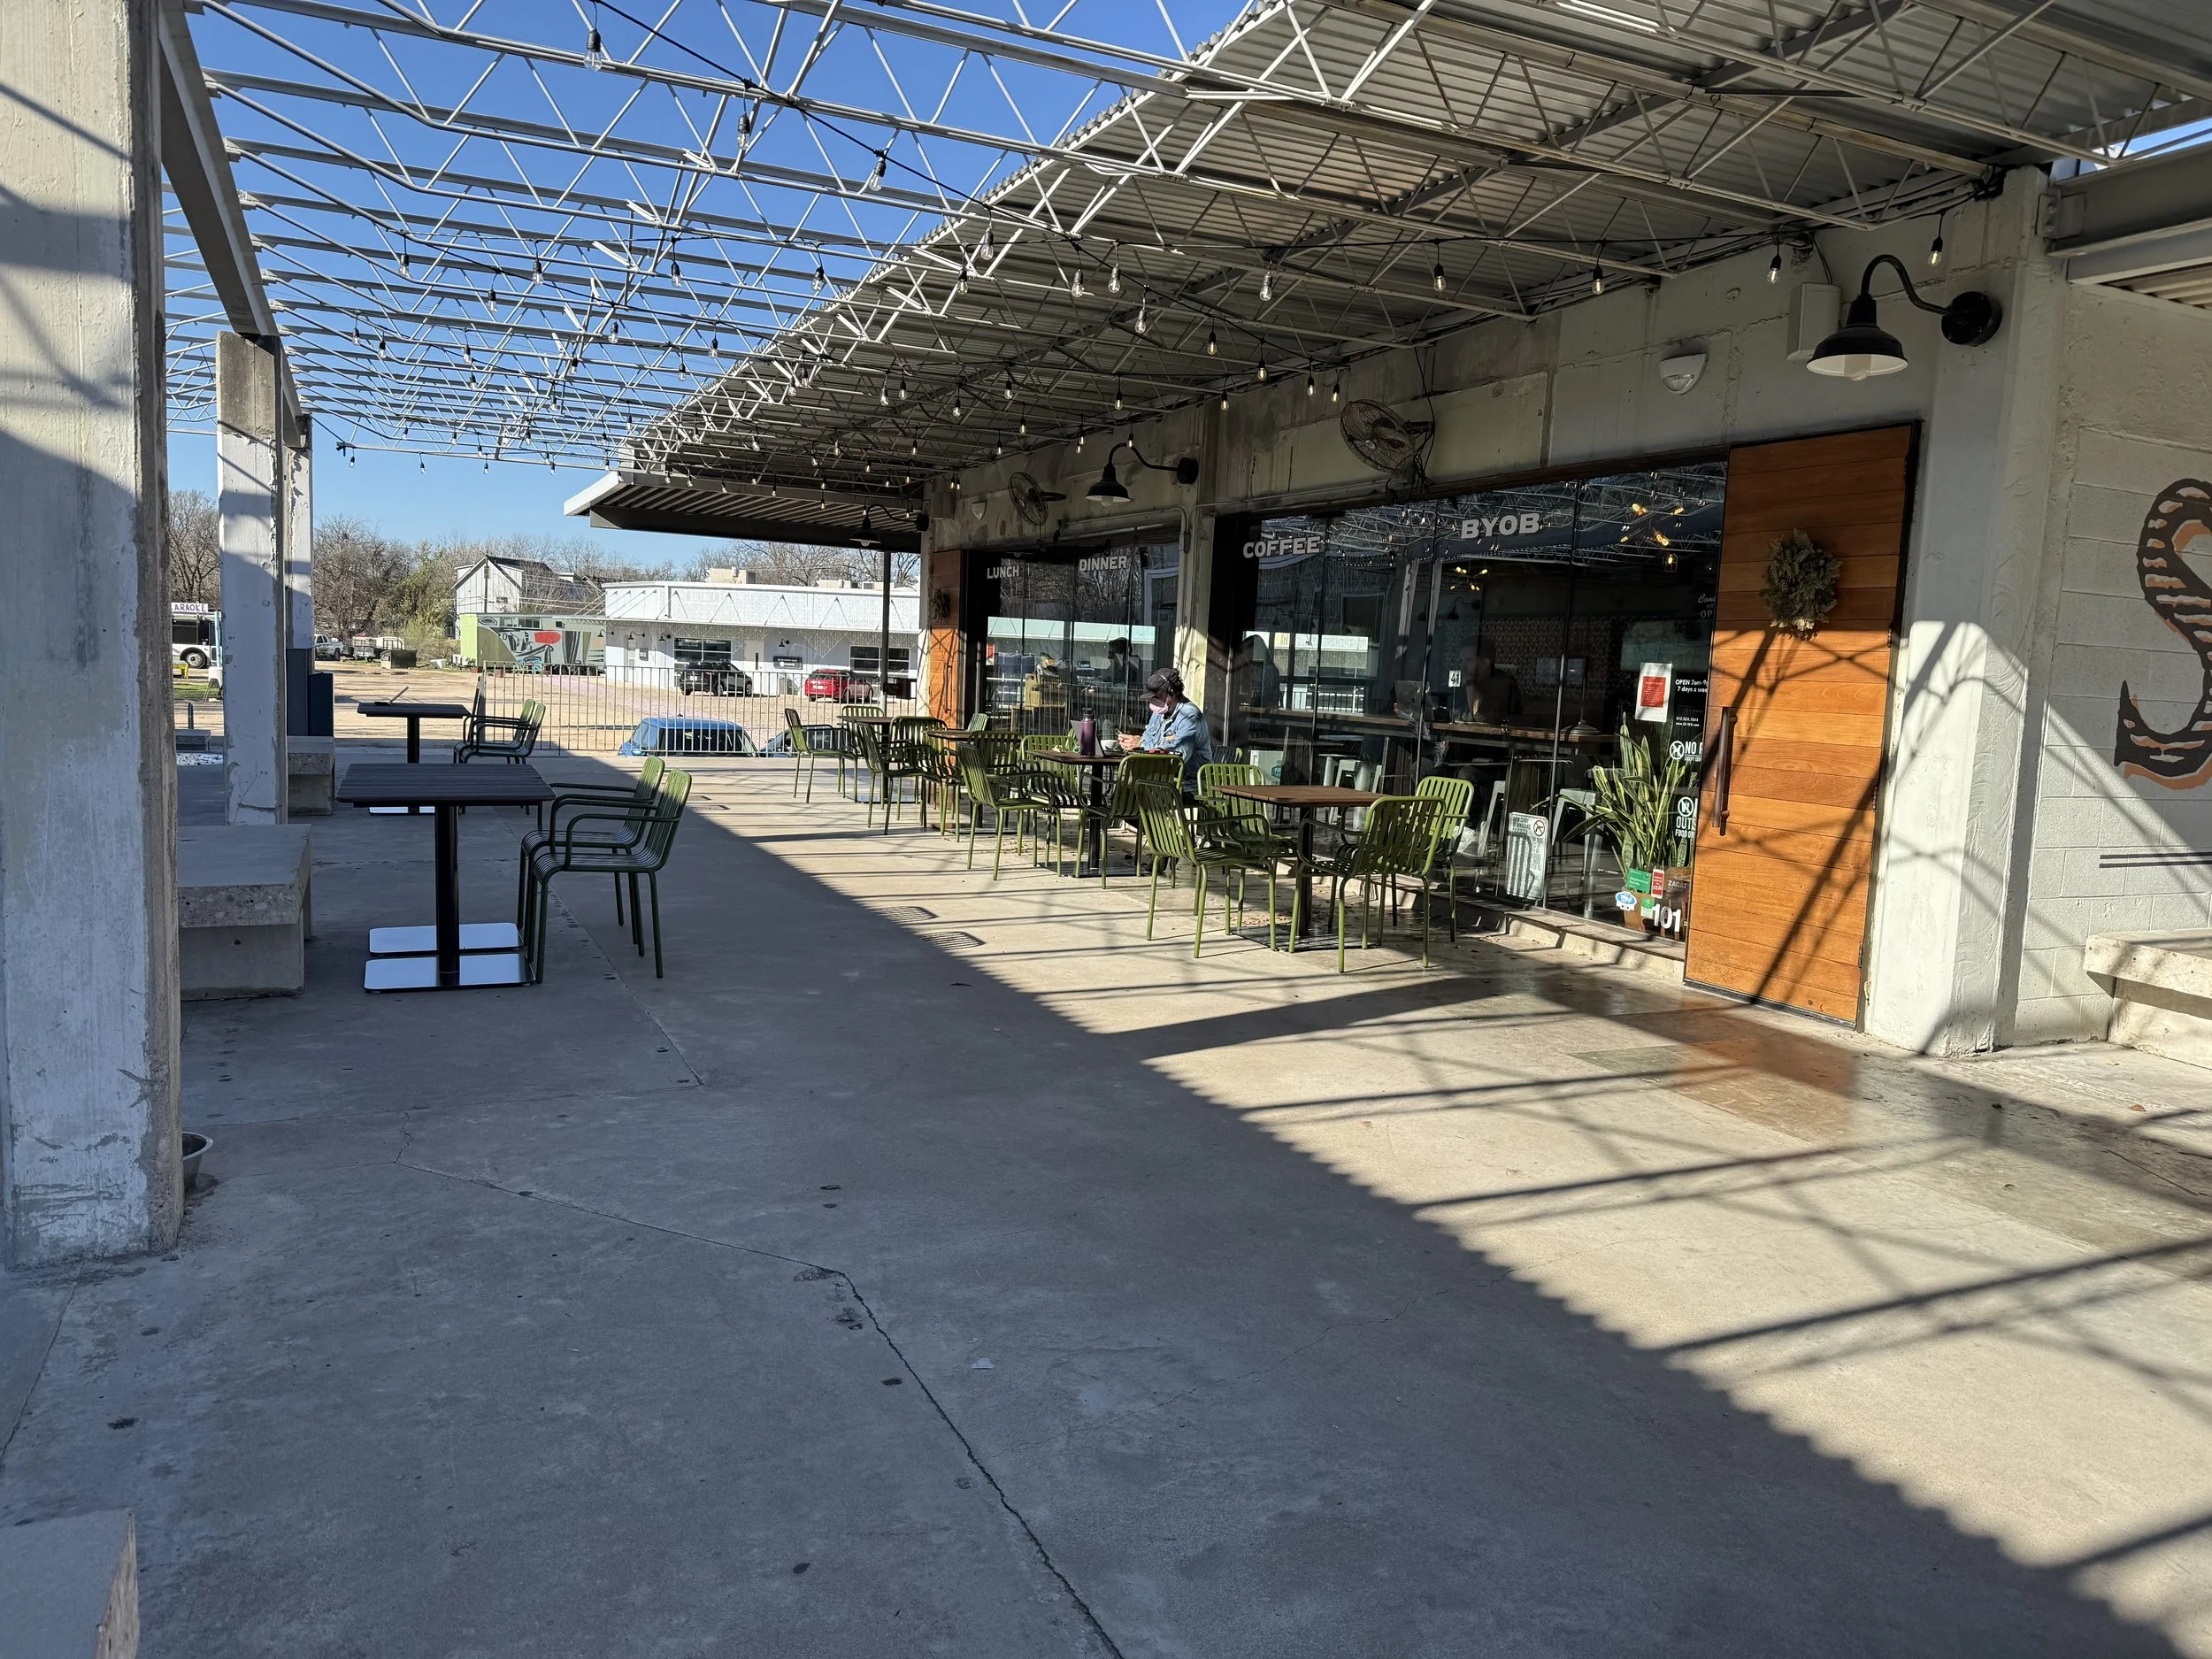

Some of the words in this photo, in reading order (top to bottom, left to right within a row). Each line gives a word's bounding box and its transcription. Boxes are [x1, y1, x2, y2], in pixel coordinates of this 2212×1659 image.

[1461, 513, 1540, 539] BYOB
[1243, 536, 1320, 558] COFFEE
[1079, 556, 1127, 572] DINNER
[987, 565, 1019, 580] LUNCH
[172, 603, 205, 612] ARAOKE
[1685, 741, 1697, 755] NO
[1651, 903, 1681, 932] 101
